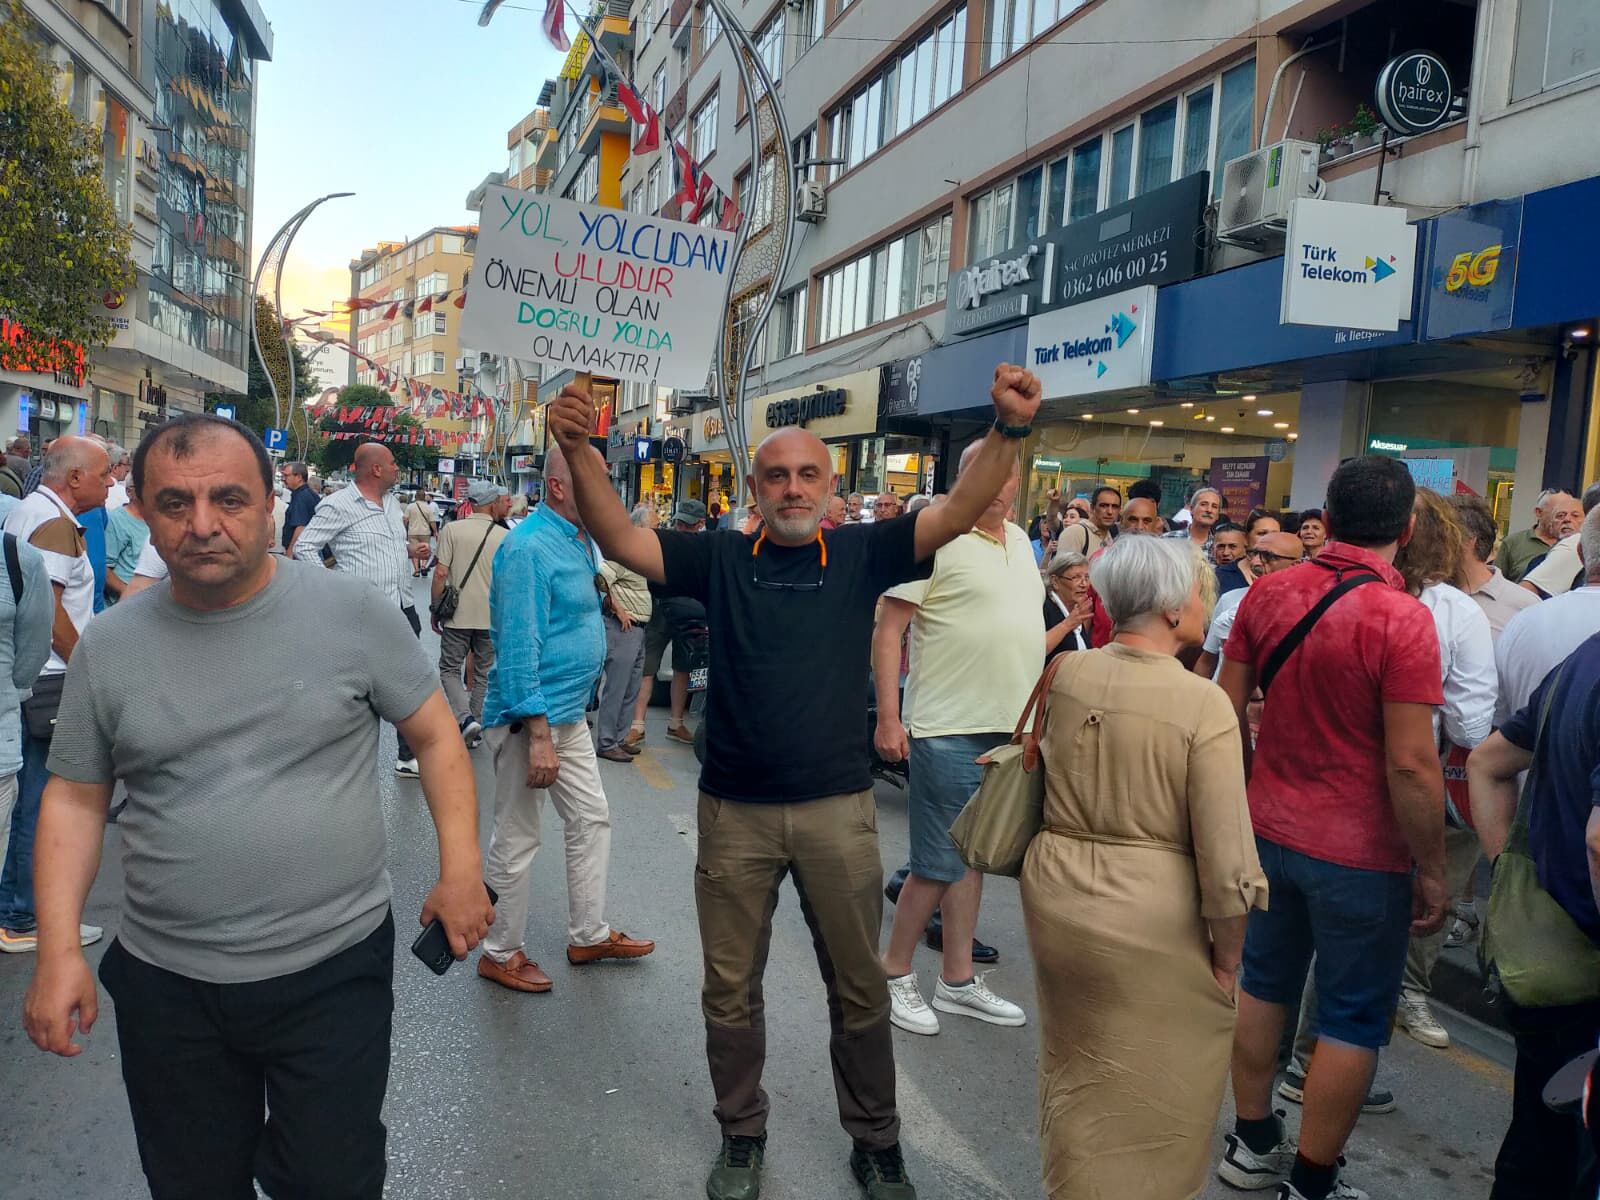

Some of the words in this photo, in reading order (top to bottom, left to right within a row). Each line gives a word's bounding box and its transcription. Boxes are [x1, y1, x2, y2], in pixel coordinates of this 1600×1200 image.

[1399, 81, 1444, 104] hairex
[500, 195, 569, 247] YOL,
[579, 211, 728, 275] YOLCUDAN
[1082, 245, 1119, 269] PROTEZ
[1302, 244, 1337, 262] Türk
[1446, 243, 1502, 292] 5G
[554, 251, 674, 298] ULUDUR
[1063, 274, 1093, 300] 0362
[1096, 265, 1122, 289] 606
[1126, 257, 1146, 280] 00
[1149, 250, 1168, 273] 25
[1300, 263, 1367, 283] Telekom
[596, 286, 660, 322] OLAN
[517, 301, 600, 338] DOĞRU
[612, 320, 673, 351] YOLDA
[1034, 344, 1060, 365] Türk
[1062, 336, 1112, 360] Telekom
[269, 430, 283, 447] P
[1369, 439, 1408, 452] Aksesuar
